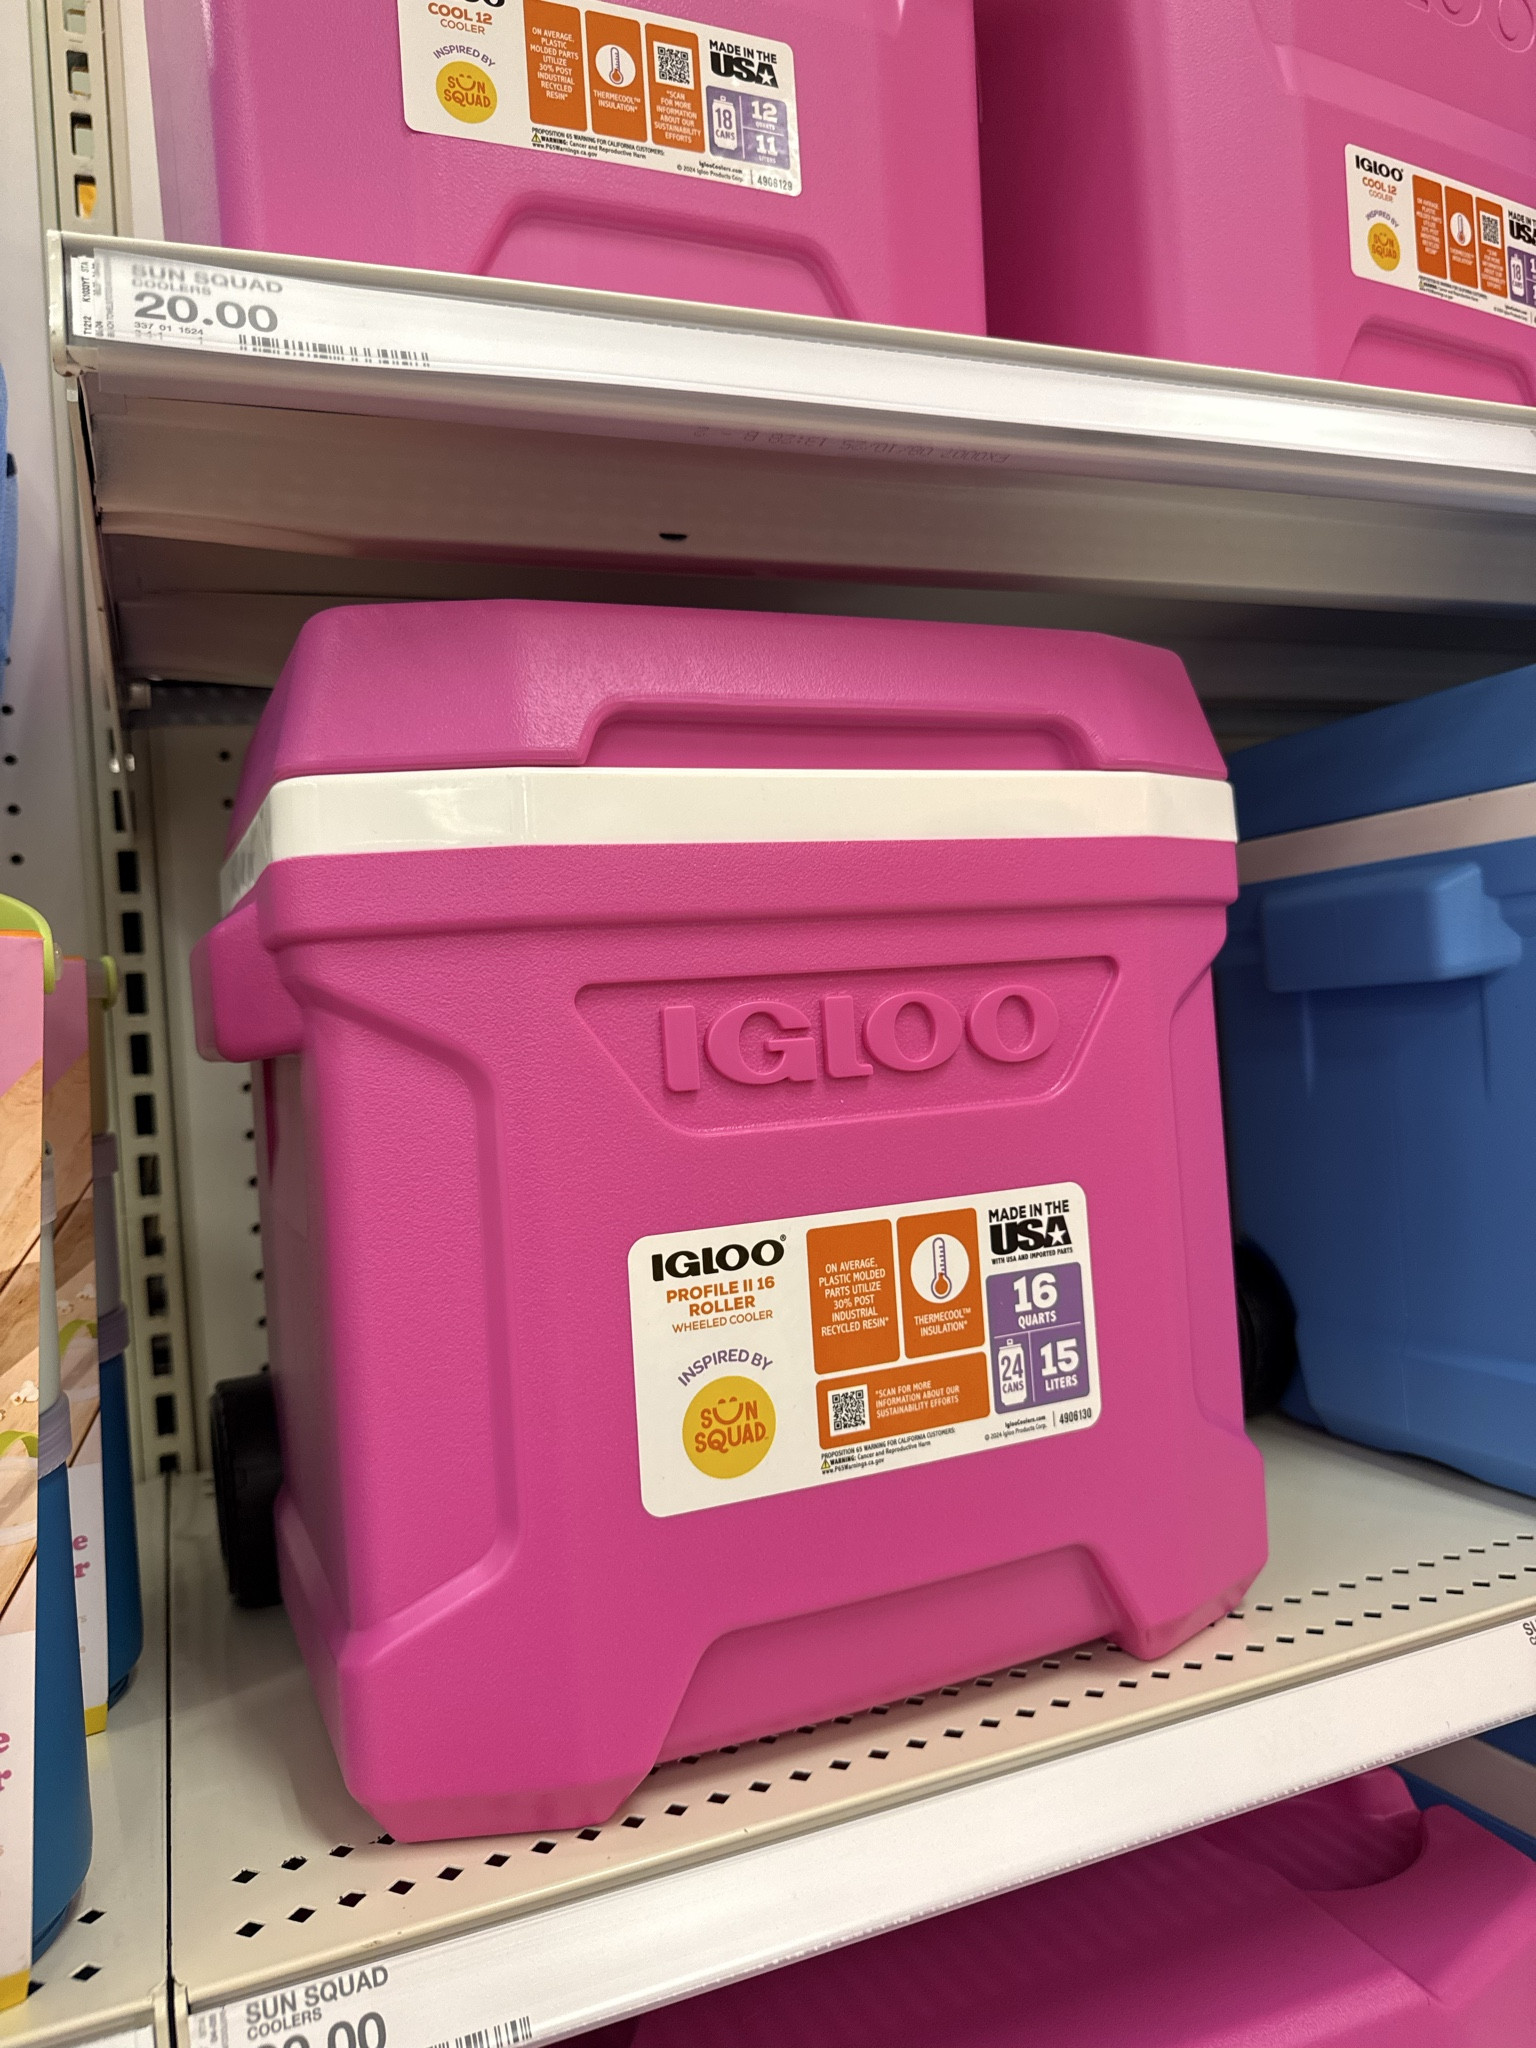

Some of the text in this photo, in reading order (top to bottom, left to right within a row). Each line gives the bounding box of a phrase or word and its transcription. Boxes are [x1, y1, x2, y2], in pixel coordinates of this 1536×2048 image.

[428, 2, 473, 21] COOL
[476, 12, 492, 25] 12
[440, 19, 485, 35] COOLER
[532, 27, 542, 35] ON
[530, 44, 579, 60] MOLDED PARTS
[541, 38, 567, 49] PLASTIC
[709, 39, 777, 64] MADE IN THE
[433, 45, 495, 67] INSPIRED BY
[543, 55, 567, 66] UTILIZE
[538, 72, 575, 85] INDUSTRIAL
[539, 63, 572, 76] 30% POST
[710, 51, 779, 88] USA
[448, 74, 486, 94] SUN
[541, 80, 572, 93] RECYCLED
[444, 89, 491, 108] SQUAD
[661, 97, 691, 110] FOR MORE
[656, 106, 697, 119] INFORMATION
[660, 114, 694, 127] ABOUT OUR
[715, 108, 733, 130] 18
[751, 100, 777, 123] 12
[654, 121, 701, 136] SUSTAINABILITY
[665, 132, 692, 144] EFFORTS
[716, 129, 735, 140] CANS
[531, 127, 565, 138] PROPOSITION
[574, 134, 596, 143] WARNING
[607, 139, 635, 150] CALIFORNIA
[756, 134, 778, 156] 11
[570, 141, 587, 149] Cancer
[599, 145, 632, 157] Reproductive
[633, 151, 646, 159] Harm
[1362, 177, 1397, 195] COOL 12
[1508, 210, 1524, 223] MADE
[1525, 217, 1531, 226] IN
[1372, 244, 1396, 259] SQUAD
[132, 264, 283, 293] SUN SQUAD
[132, 279, 211, 296] COOLERS
[134, 291, 278, 332] 20.00
[134, 322, 153, 330] 337
[179, 327, 203, 335] 1524
[660, 984, 1060, 1095] IGLOO
[988, 1199, 1069, 1223] MADE IN THE
[989, 1215, 1072, 1255] USA
[991, 1257, 1005, 1265] WITH
[1018, 1253, 1028, 1261] AND
[1030, 1250, 1056, 1259] IMPORTED
[1057, 1247, 1073, 1255] PARTS
[818, 1268, 886, 1287] PLASTIC MOLDED
[825, 1263, 837, 1274] ON
[666, 1276, 775, 1303] PROFILE II 16
[824, 1280, 882, 1299] PARTS UTILIZE
[1013, 1272, 1058, 1313] 16
[689, 1295, 755, 1317] ROLLER
[833, 1294, 875, 1310] 30% POST
[672, 1309, 773, 1333] WHEELED COOLER
[832, 1306, 878, 1323] INDUSTRIAL
[1018, 1310, 1057, 1330] QUARTS
[821, 1322, 860, 1337] RECYCLED
[1040, 1338, 1079, 1376] 15
[678, 1348, 773, 1387] INSPIRED BY
[1001, 1353, 1023, 1381] 24
[898, 1384, 911, 1394] FOR
[912, 1380, 932, 1391] MORE
[1002, 1380, 1024, 1394] CANS
[1045, 1374, 1077, 1392] LITERS
[876, 1385, 960, 1408] INFORMATION ABOUT OUR
[700, 1397, 758, 1429] SUN
[876, 1395, 959, 1419] SUSTAINABILITY EFFORTS
[1059, 1407, 1092, 1424] 4906130
[694, 1421, 767, 1454] SQUAD
[990, 1431, 1002, 1439] 2024
[1003, 1429, 1014, 1438] Igloo
[1015, 1425, 1035, 1434] Products
[821, 1447, 855, 1460] PROPOSITION
[864, 1441, 886, 1451] WARNING
[887, 1438, 897, 1446] FOR
[898, 1433, 926, 1445] CALIFORNIA
[830, 1440, 931, 1466] WARNING: Cancer and Reproductive Harm
[246, 1965, 389, 2025] SUN SQUAD
[247, 2007, 322, 2041] COOLERS
